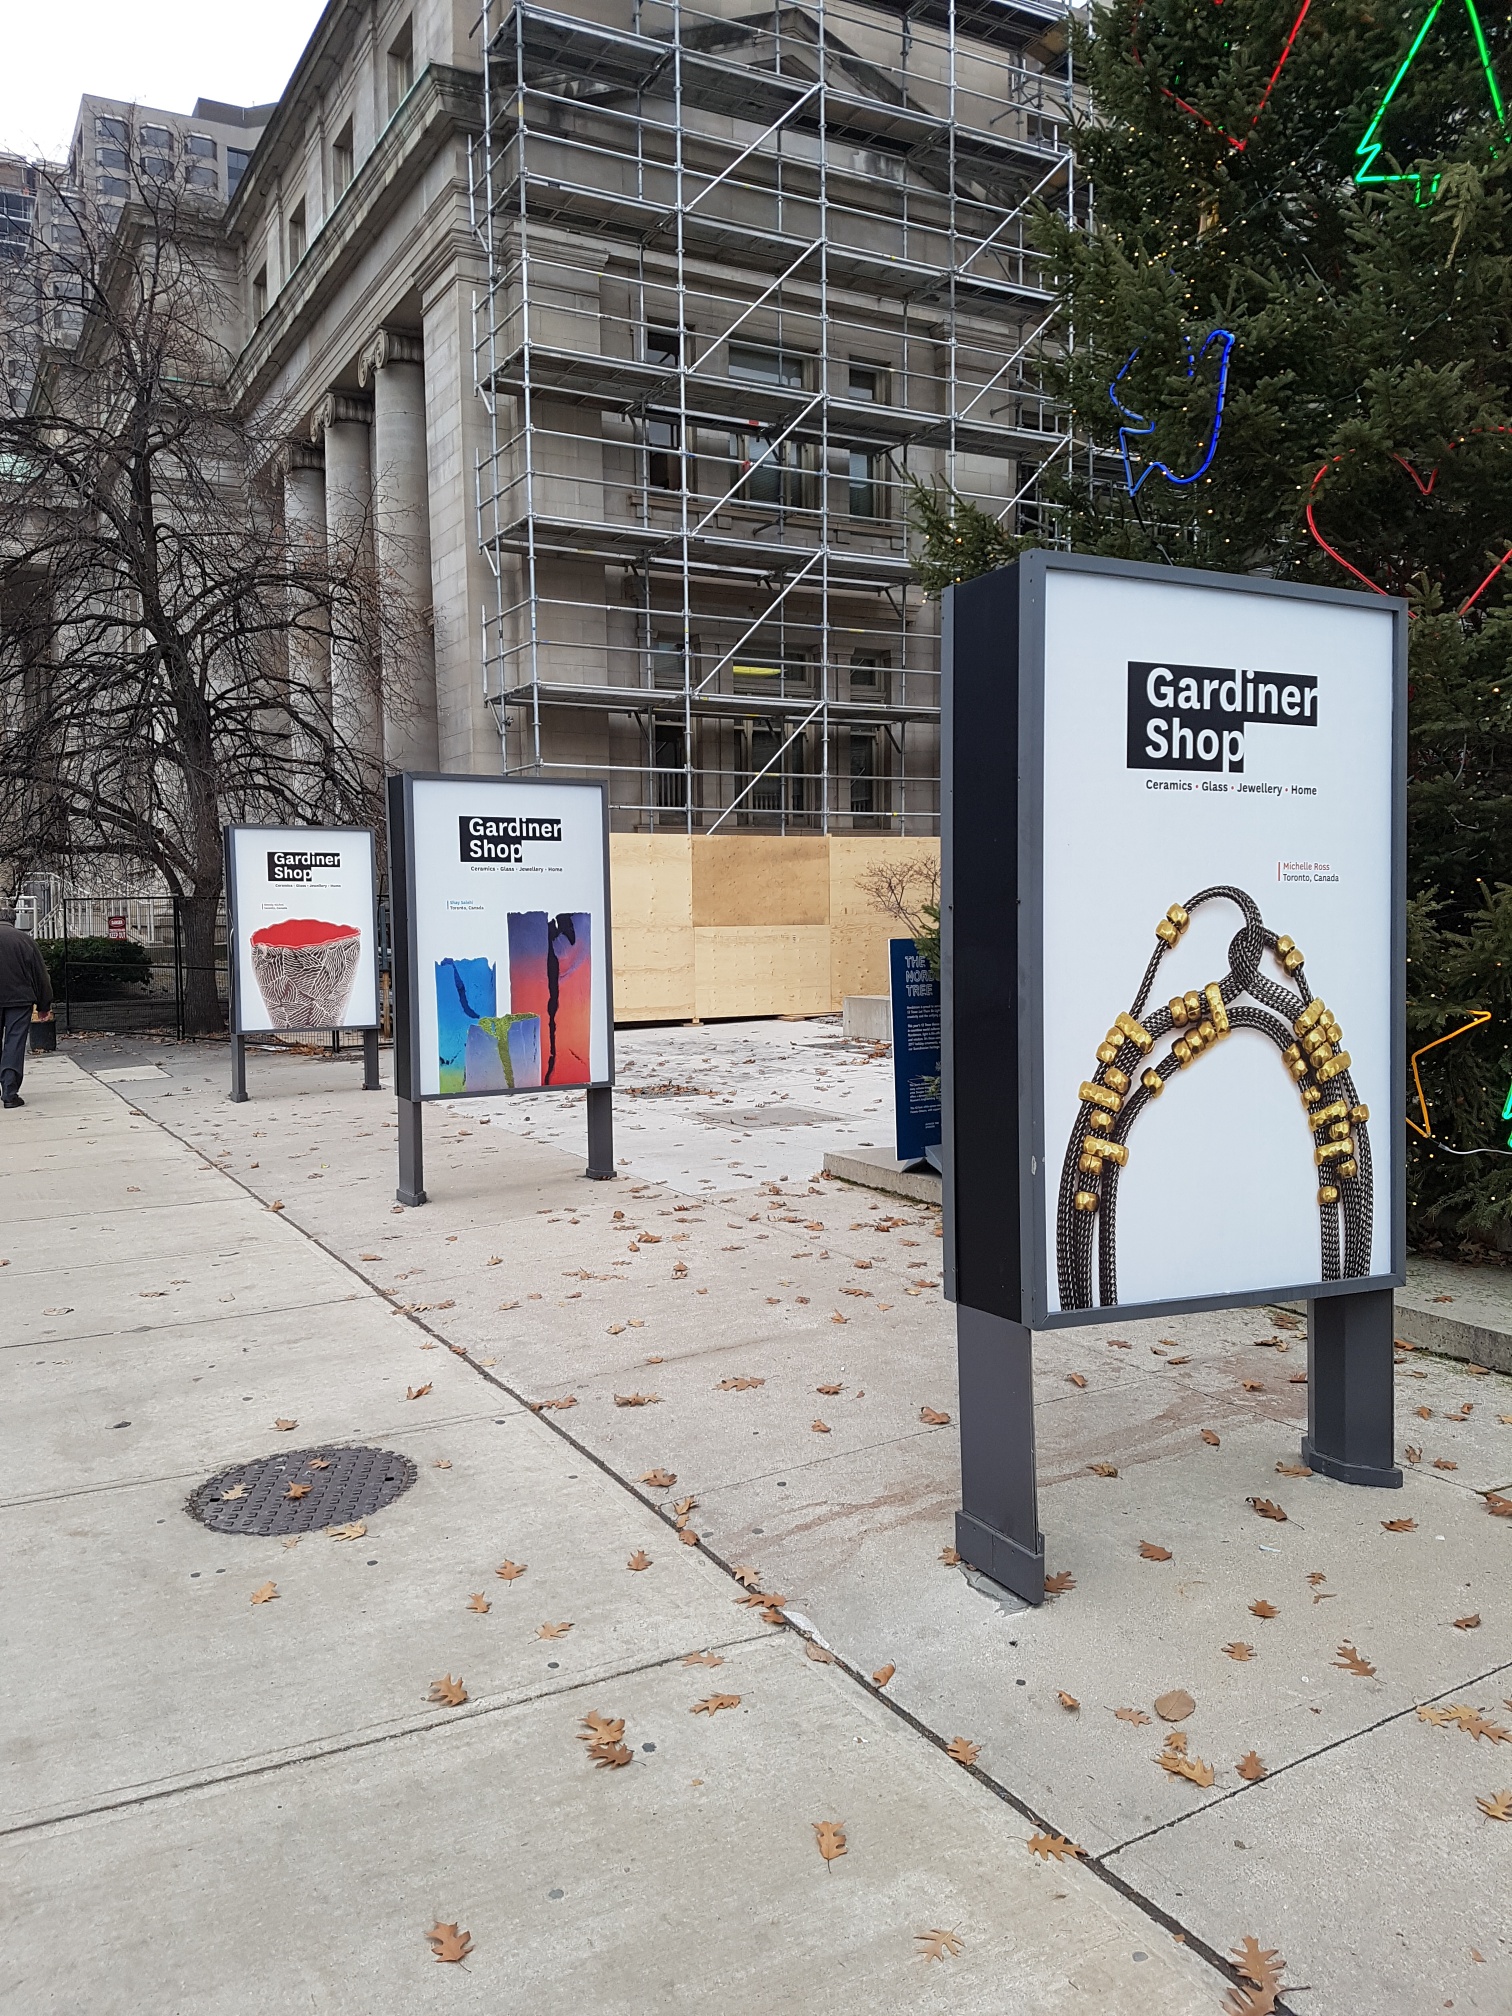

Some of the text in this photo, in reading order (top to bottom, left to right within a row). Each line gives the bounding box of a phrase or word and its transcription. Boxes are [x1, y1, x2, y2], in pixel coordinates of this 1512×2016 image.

[1146, 667, 1318, 717] Gardiner
[1145, 717, 1244, 773] Shop
[1145, 779, 1317, 796] Ceramics Glass Jewellery Home
[469, 817, 561, 837] Gardiner
[274, 852, 341, 865] Gardiner
[469, 839, 522, 863] Shop
[274, 866, 312, 882] Shop
[1283, 862, 1330, 871] Michelle Ross
[1283, 873, 1339, 883] Toronto, Canada
[904, 955, 926, 968] THE
[905, 984, 933, 997] TREE
